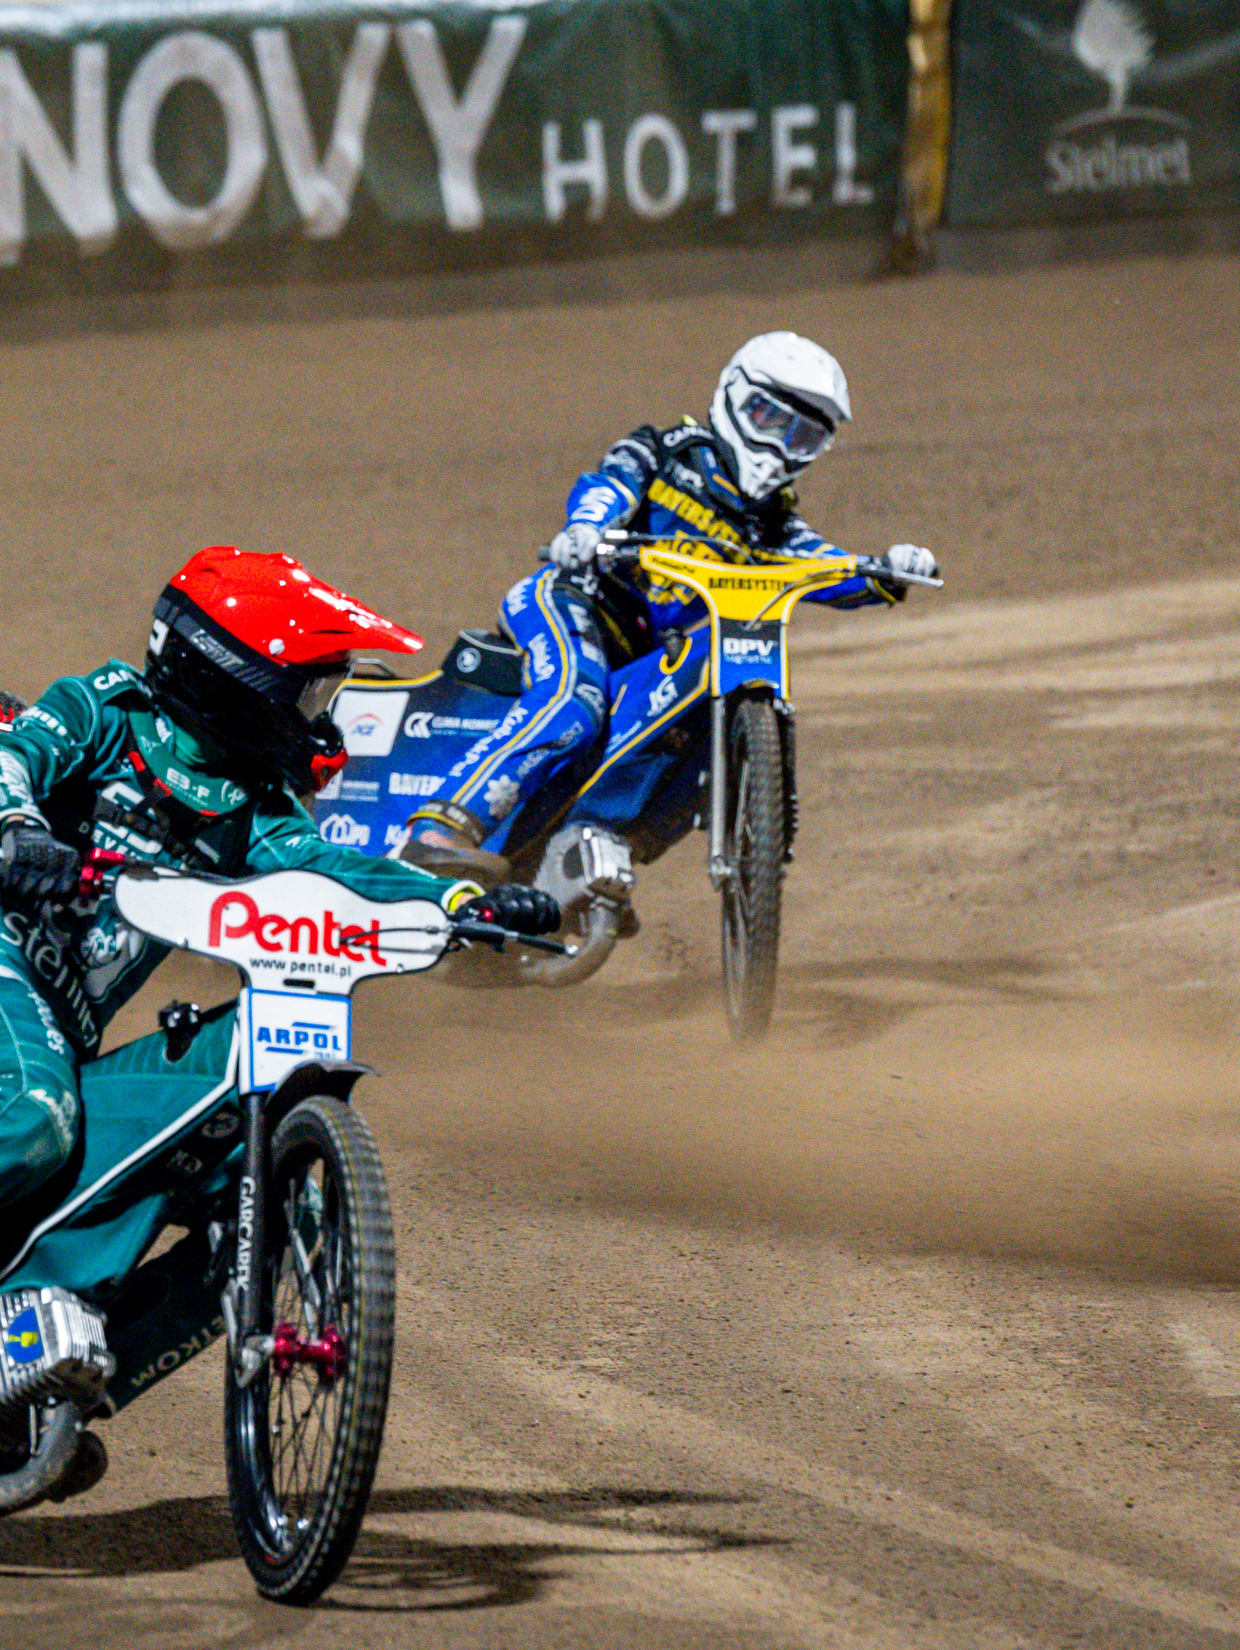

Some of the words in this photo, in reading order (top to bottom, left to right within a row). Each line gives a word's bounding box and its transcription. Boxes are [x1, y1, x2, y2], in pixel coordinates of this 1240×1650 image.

[542, 104, 873, 222] HOTEL
[723, 637, 774, 656] DPV
[208, 890, 387, 966] Pentel
[257, 1026, 342, 1051] ARPOL
